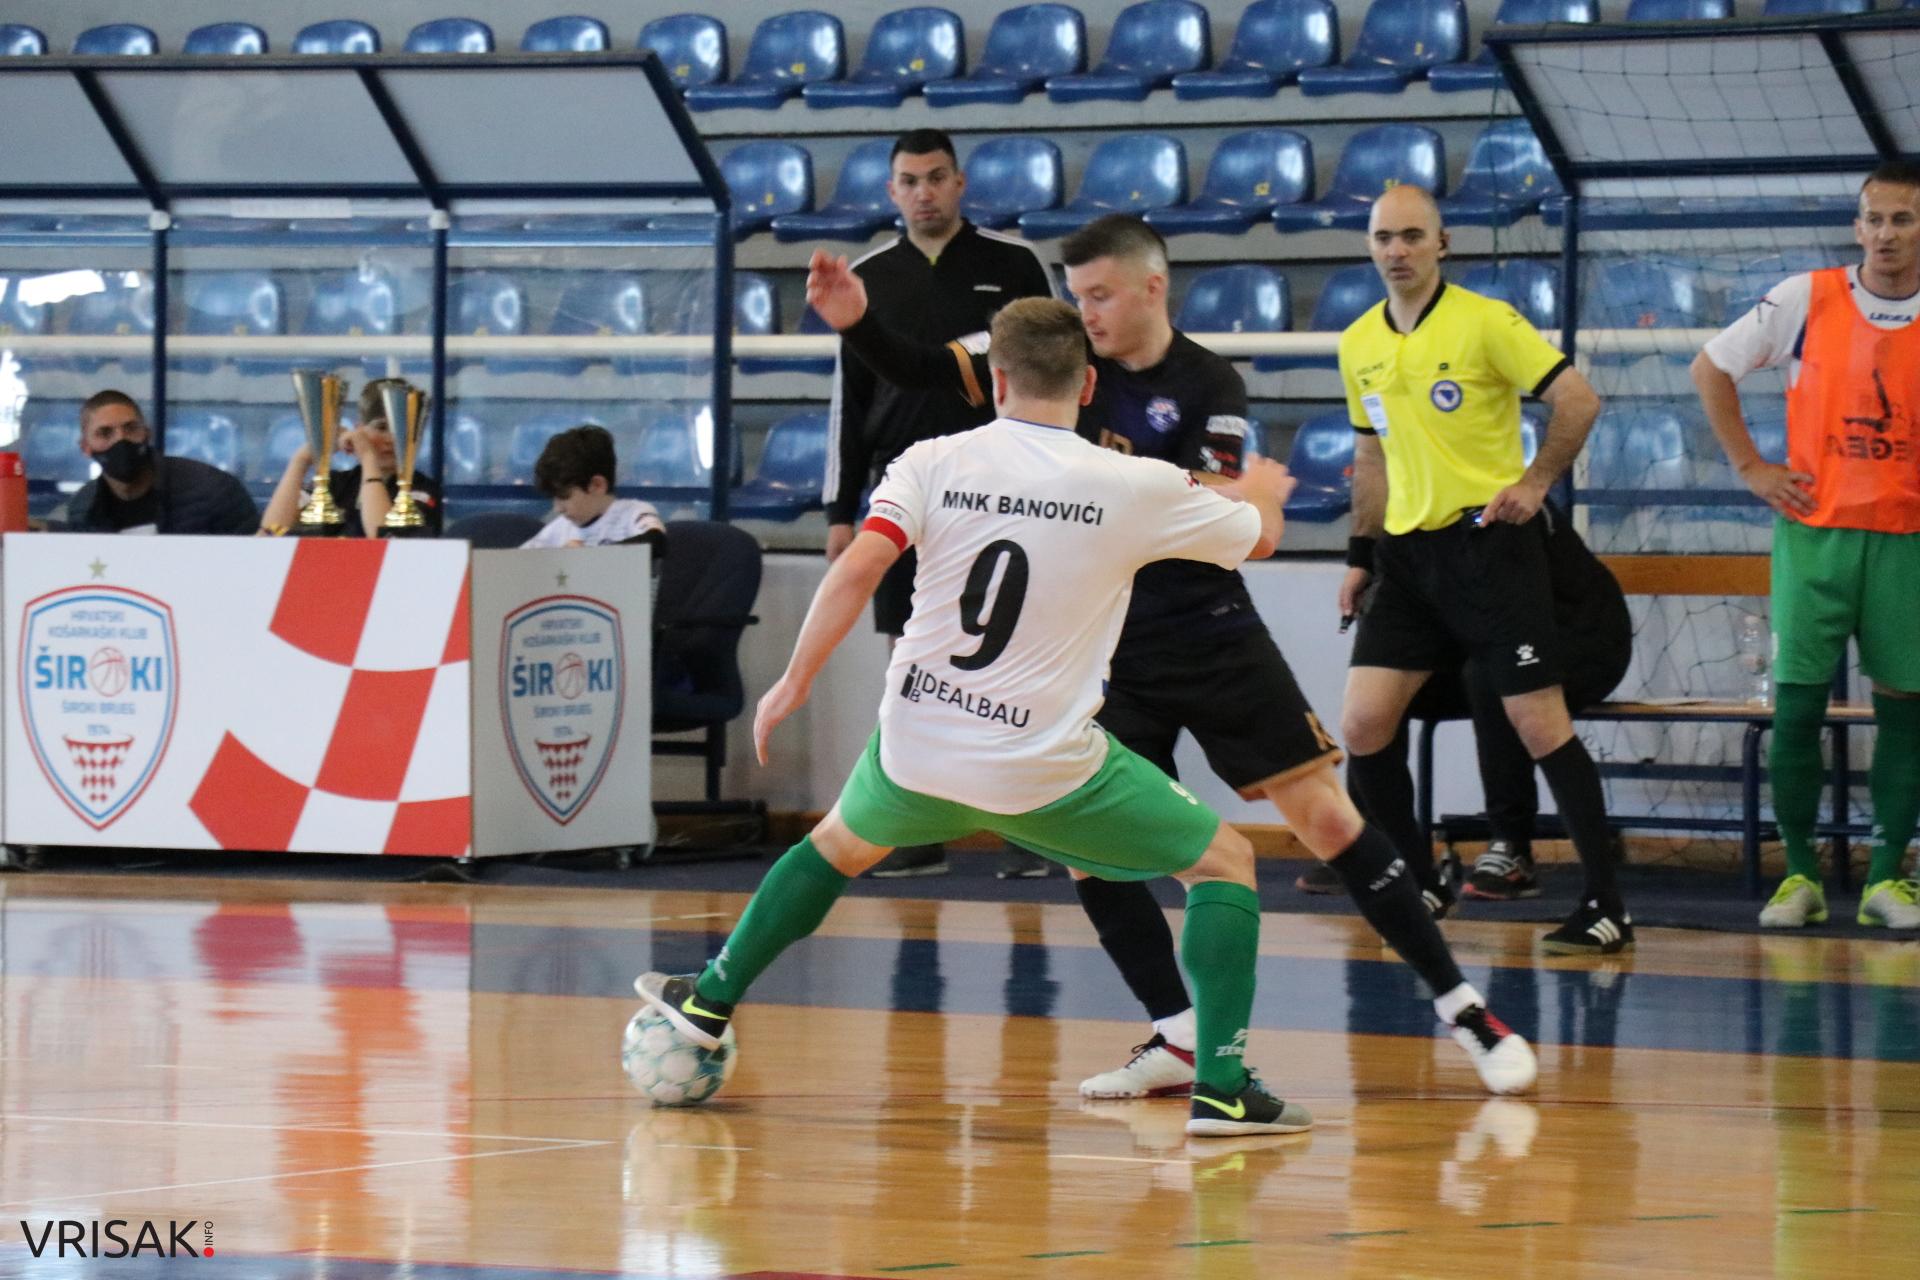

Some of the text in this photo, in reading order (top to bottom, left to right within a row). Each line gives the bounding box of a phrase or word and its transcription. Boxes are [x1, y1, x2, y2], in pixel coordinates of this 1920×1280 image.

[942, 490, 1104, 526] MNK BANOVIĆI
[949, 539, 1029, 671] 9
[915, 670, 1031, 728] IDEALBAU
